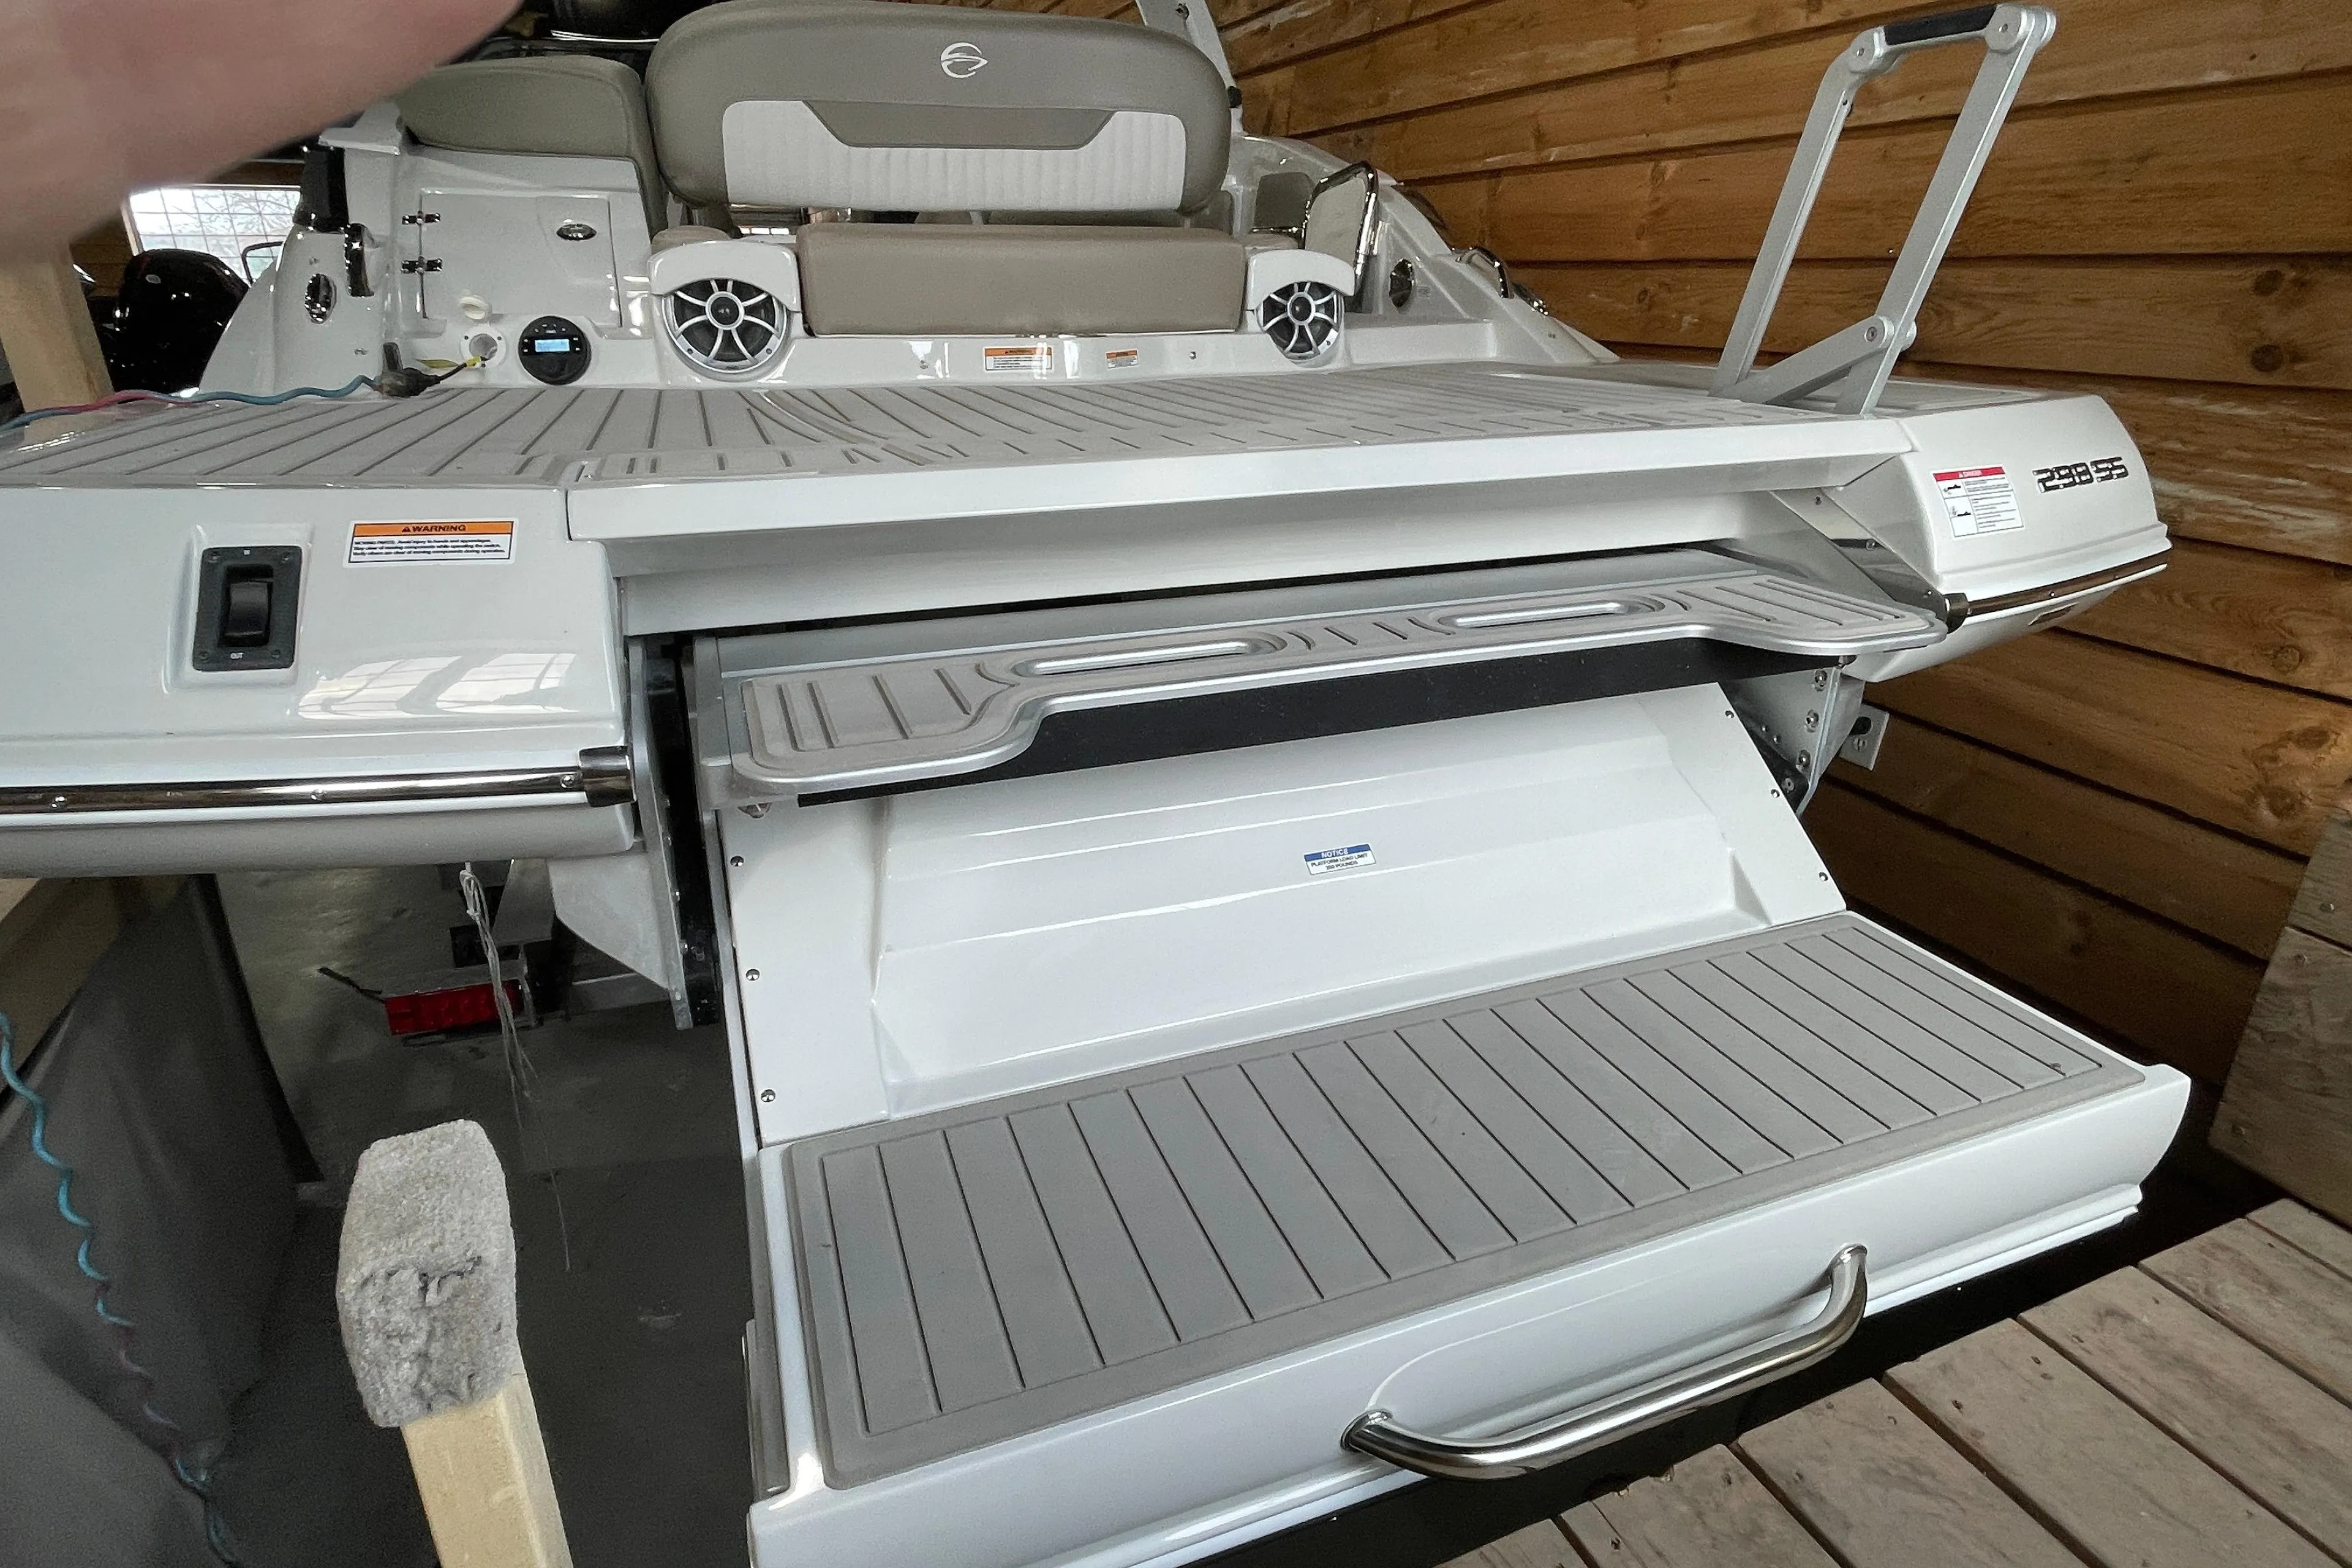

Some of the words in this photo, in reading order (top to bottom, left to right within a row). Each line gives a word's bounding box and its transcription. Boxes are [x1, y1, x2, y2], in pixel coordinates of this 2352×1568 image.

[2032, 462, 2094, 493] 298
[1321, 848, 1349, 859] NOTICE
[1311, 858, 1339, 867] PLATFORM
